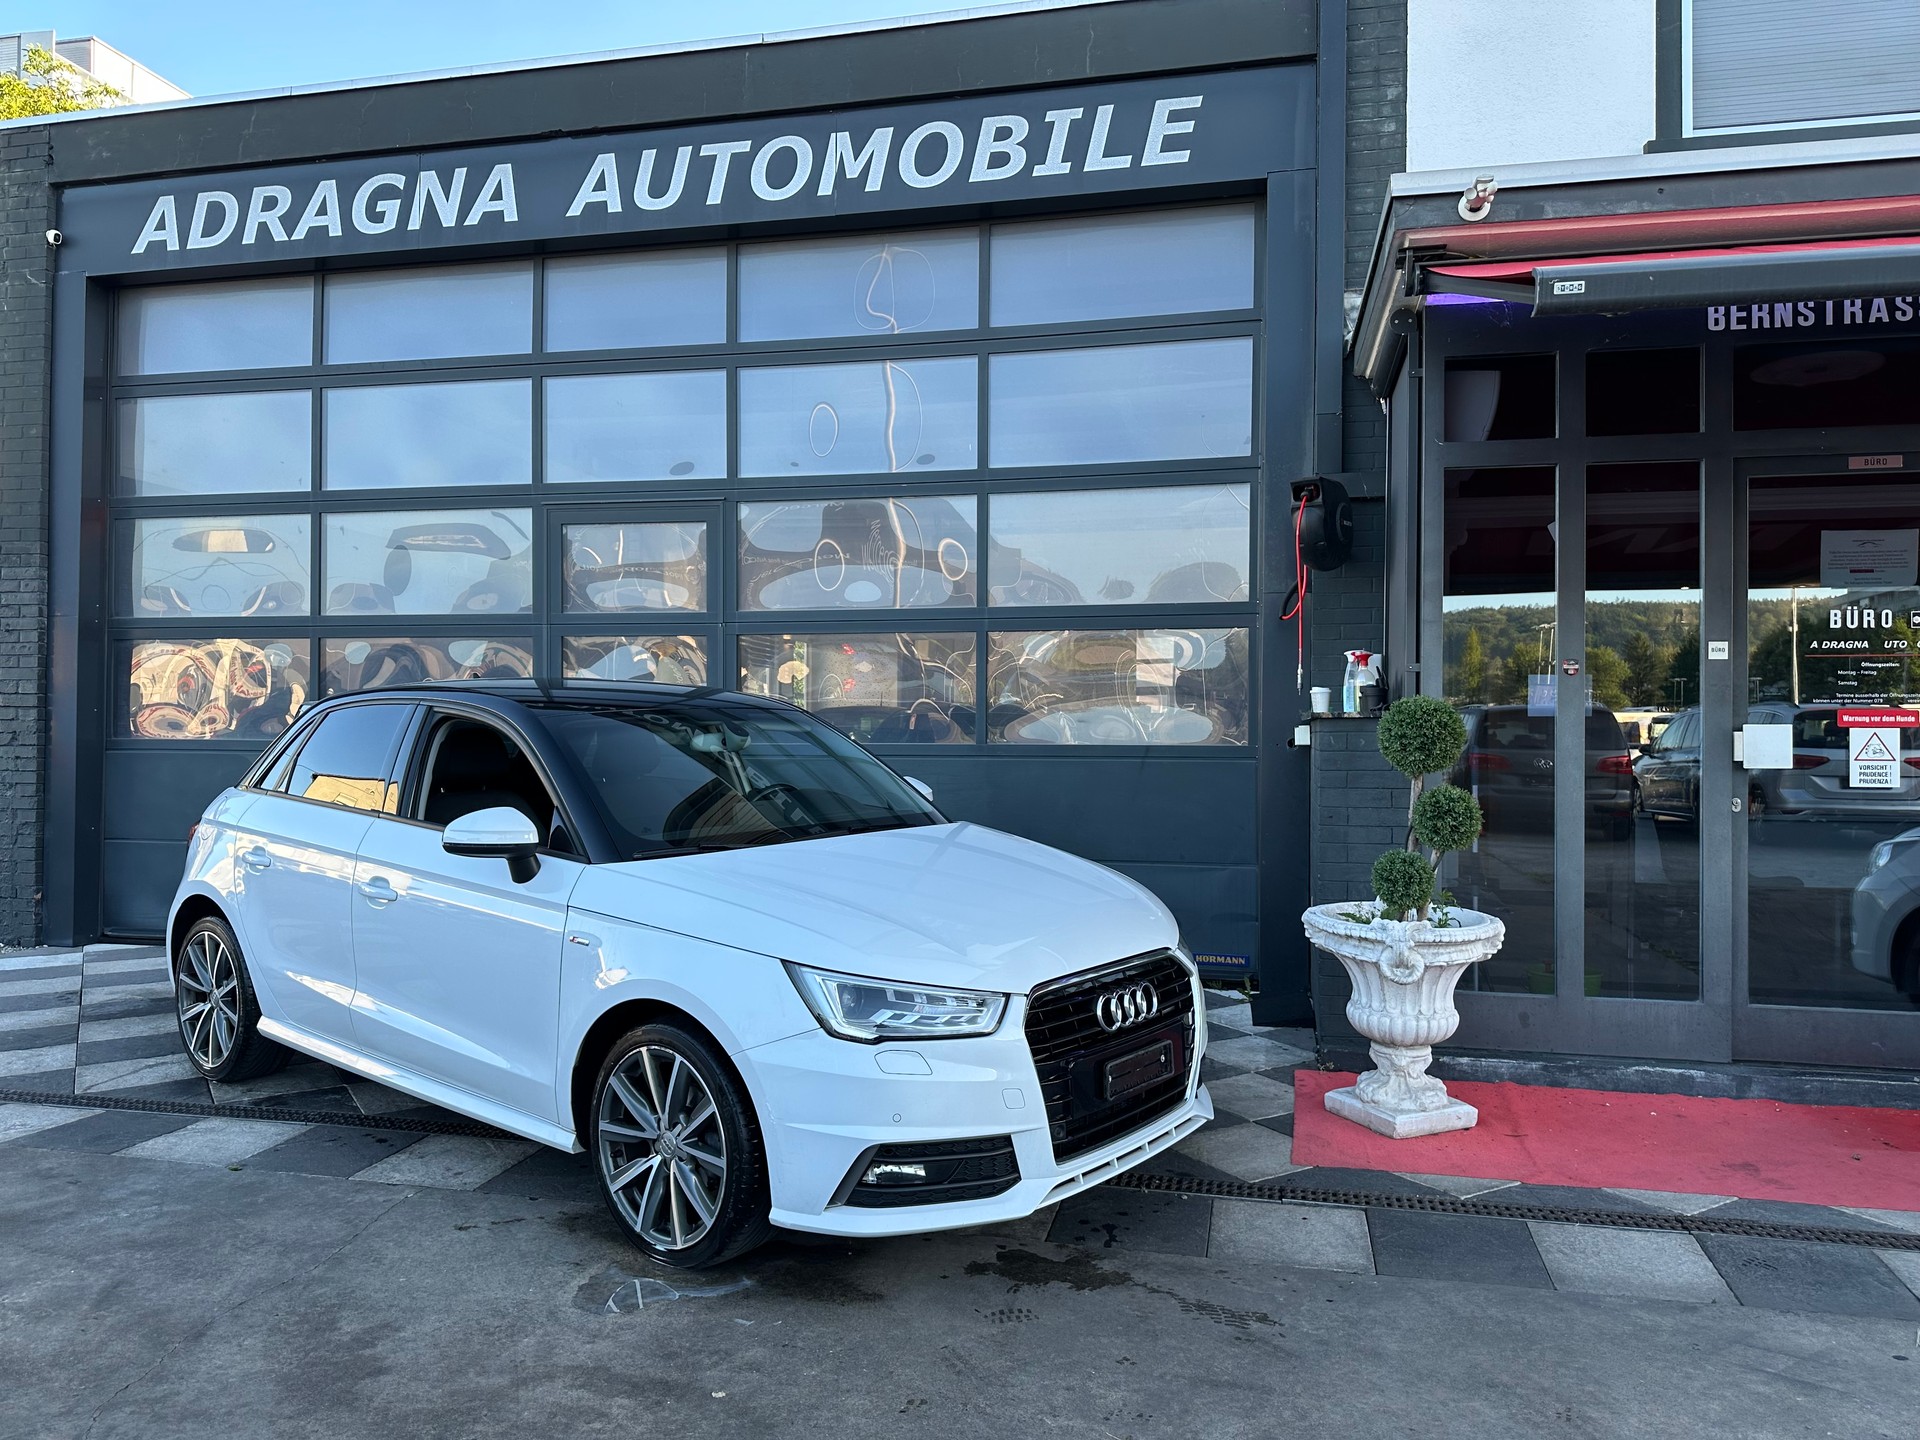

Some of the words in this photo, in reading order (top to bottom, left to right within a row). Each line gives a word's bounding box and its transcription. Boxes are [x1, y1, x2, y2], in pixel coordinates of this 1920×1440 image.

[130, 163, 519, 255] ADRAGNA
[565, 94, 1204, 218] AUTOMOBILE
[1707, 296, 1920, 331] BERNSTRAS
[1864, 457, 1888, 466] BÜRO
[1830, 606, 1892, 629] BÜRO
[1842, 715, 1870, 723] Warnung
